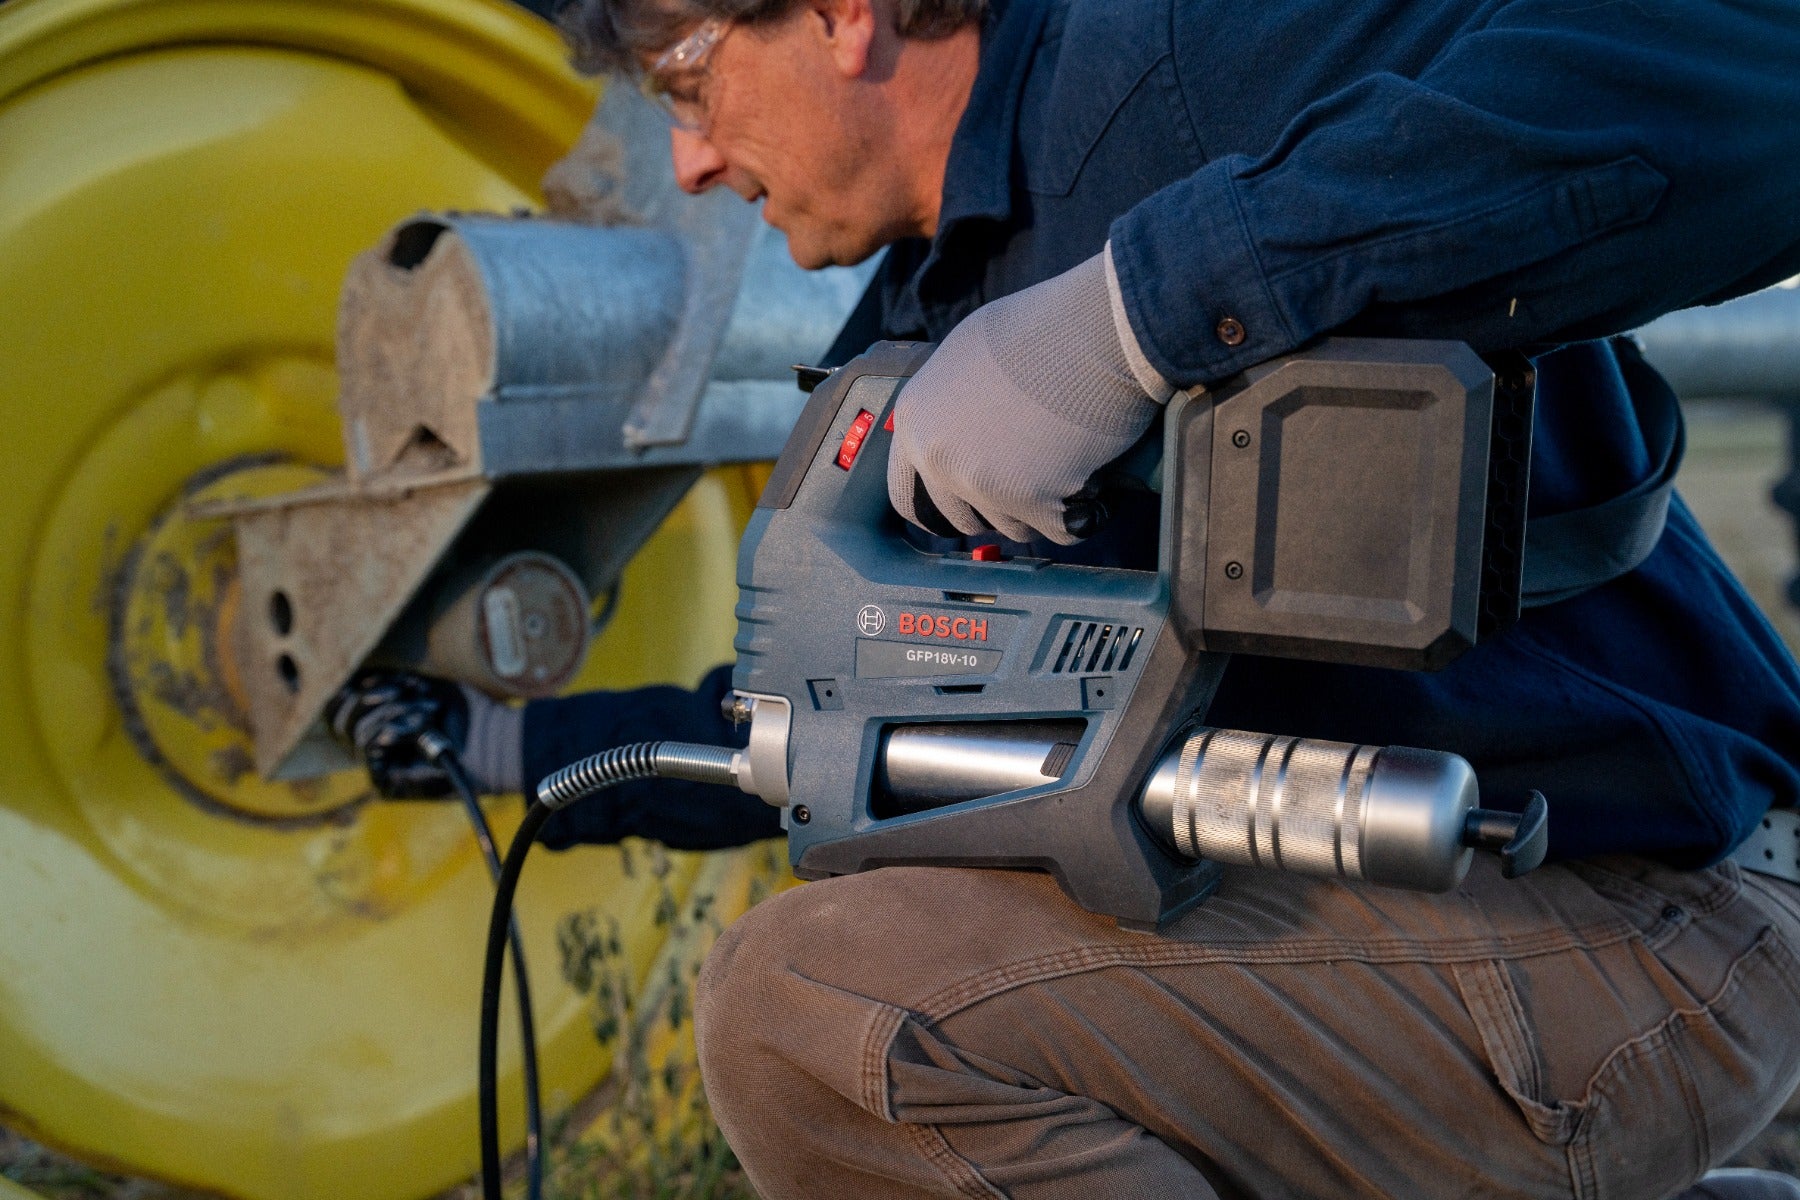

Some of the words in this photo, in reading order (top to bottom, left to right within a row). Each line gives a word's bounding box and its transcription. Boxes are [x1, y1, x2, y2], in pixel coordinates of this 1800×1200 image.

[863, 413, 874, 421] 5
[855, 425, 864, 434] 4
[846, 440, 856, 449] 3
[842, 454, 851, 463] 2
[899, 612, 988, 641] BOSCH
[906, 650, 977, 667] GFP18V-10
